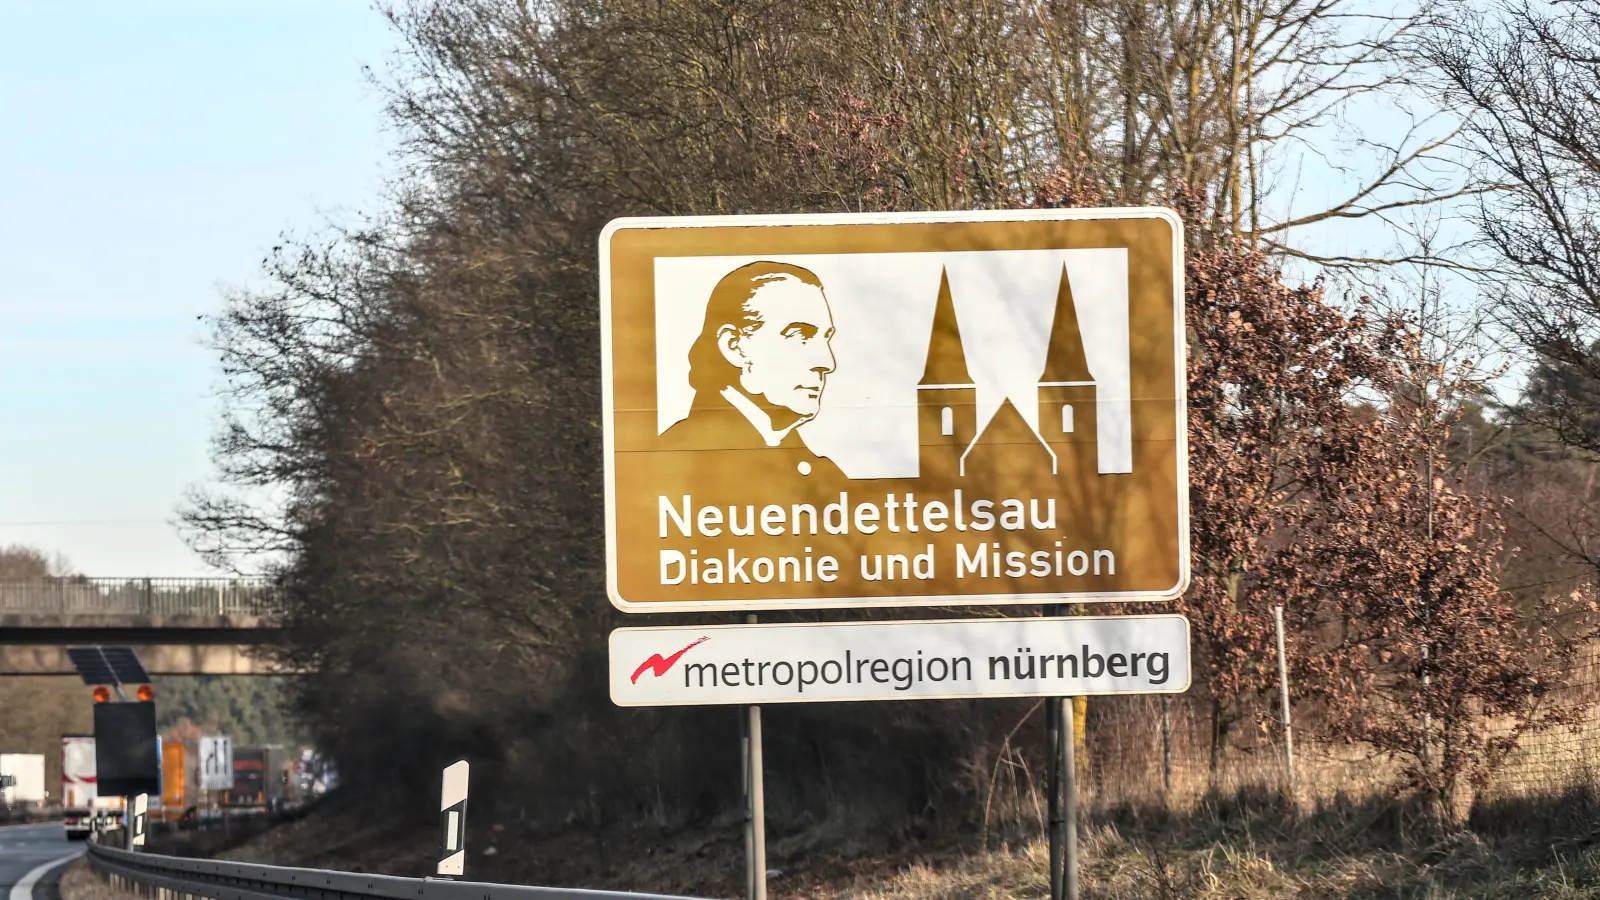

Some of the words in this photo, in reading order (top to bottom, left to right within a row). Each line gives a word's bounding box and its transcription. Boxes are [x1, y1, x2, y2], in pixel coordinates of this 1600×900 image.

[658, 488, 1057, 538] Neuendettelsau
[659, 546, 840, 585] Diakonie
[860, 543, 936, 582] und
[955, 540, 1116, 579] Mission
[684, 649, 972, 693] metropolregion
[988, 644, 1170, 685] nürnberg
